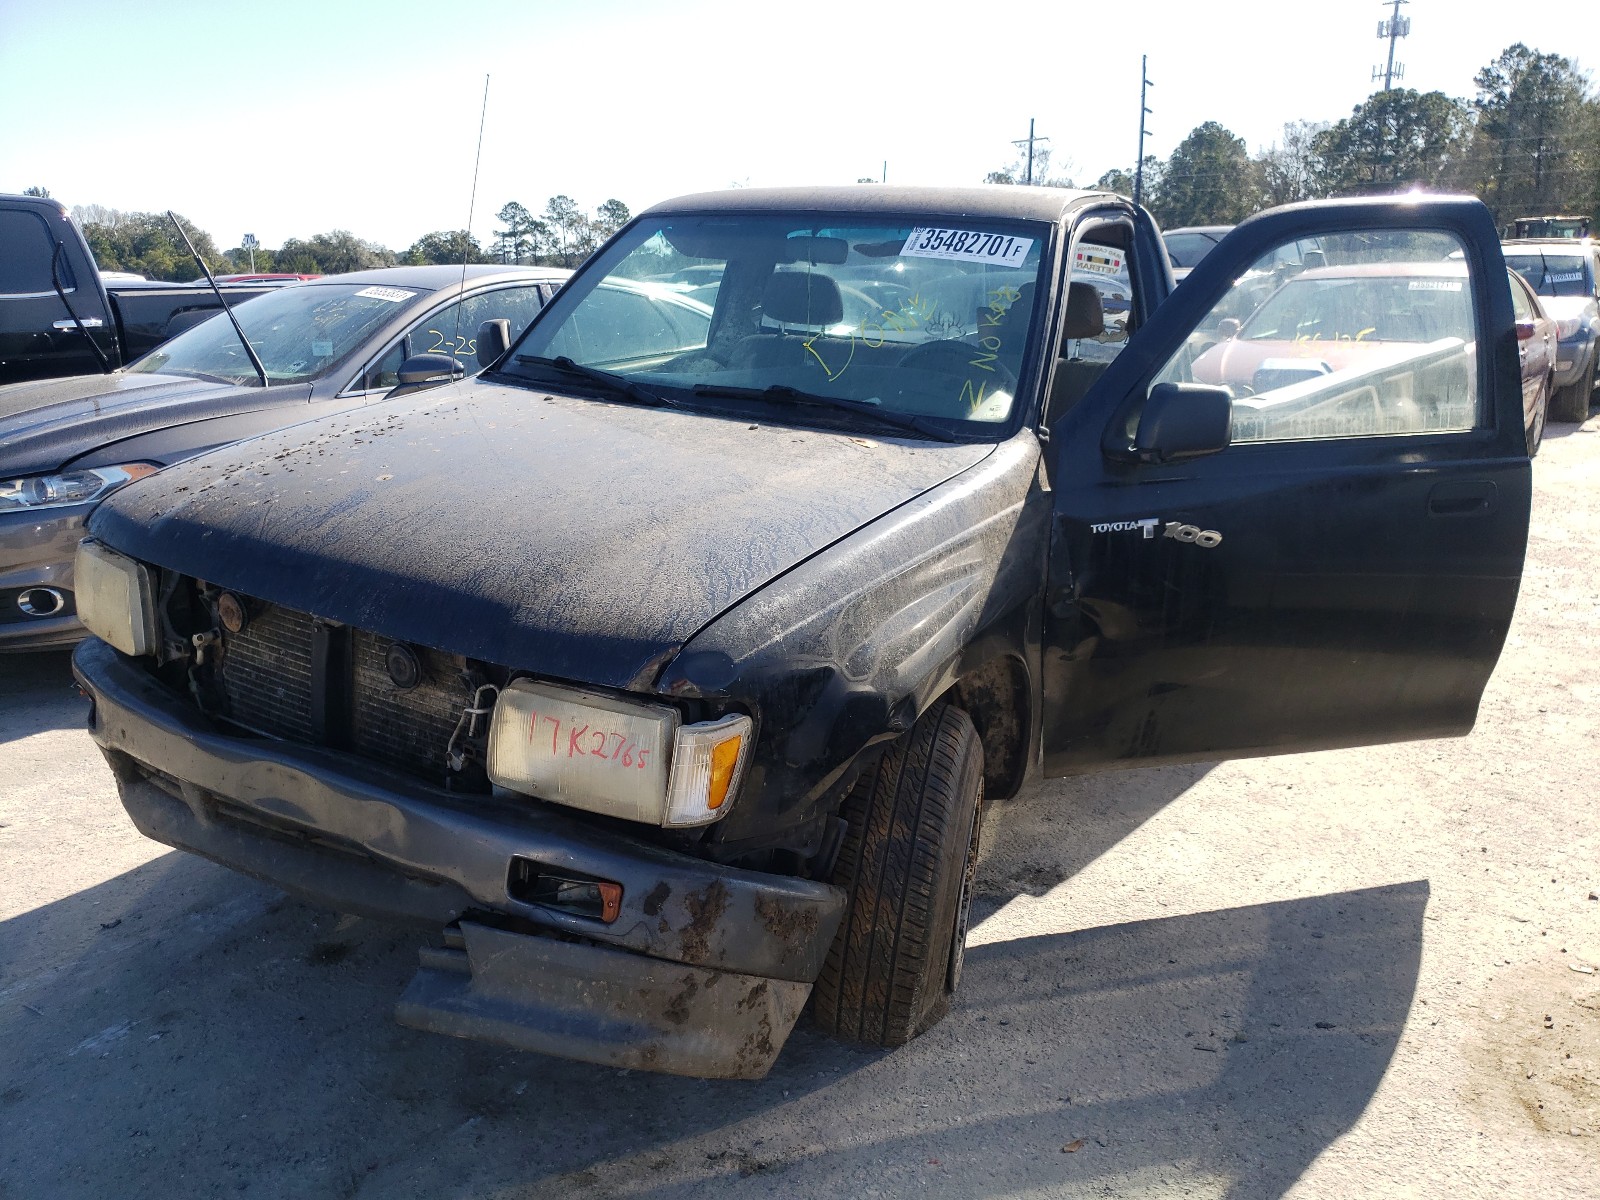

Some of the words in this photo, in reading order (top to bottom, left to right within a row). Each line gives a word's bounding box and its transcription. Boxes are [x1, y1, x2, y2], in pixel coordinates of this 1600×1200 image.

[919, 229, 1015, 257] 35482701
[1012, 245, 1022, 256] F
[1091, 521, 1138, 534] TOYOTA
[529, 710, 650, 769] 17K2765
